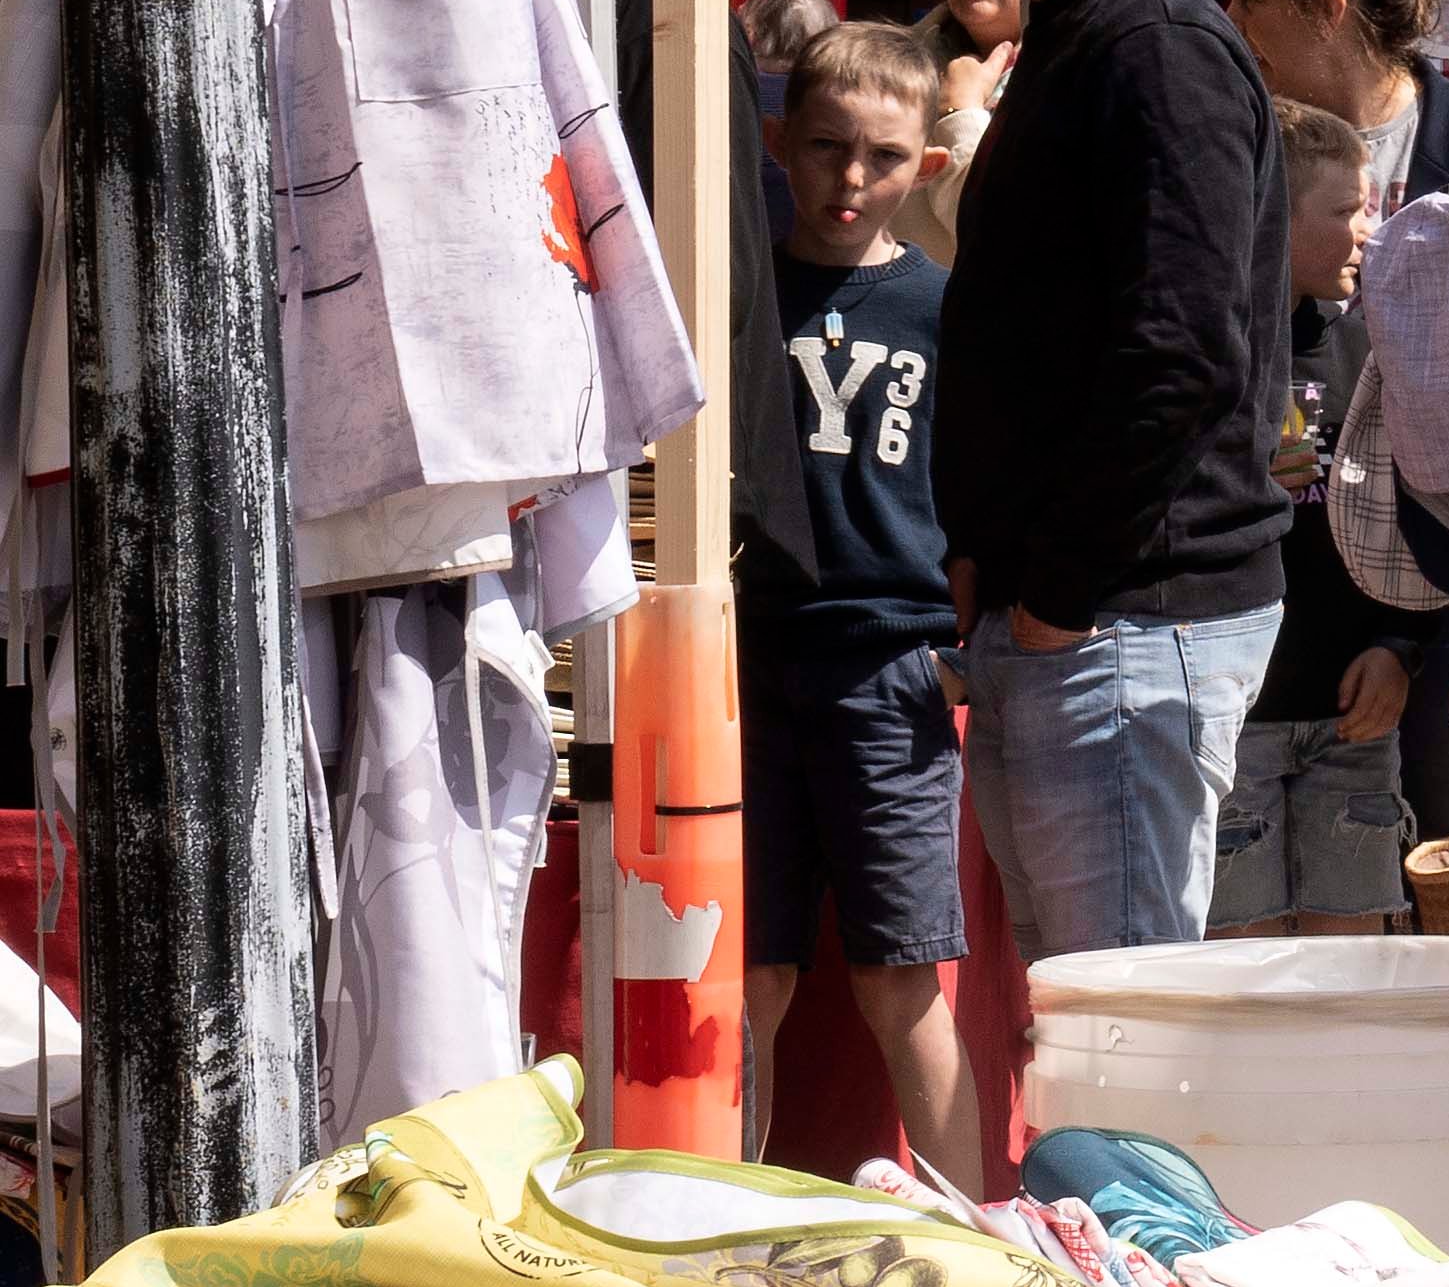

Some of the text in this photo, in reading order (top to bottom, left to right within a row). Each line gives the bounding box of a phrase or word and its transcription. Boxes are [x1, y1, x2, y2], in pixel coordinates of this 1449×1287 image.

[789, 336, 927, 455] Y 3
[876, 406, 912, 466] 6
[492, 1232, 516, 1253] ALL
